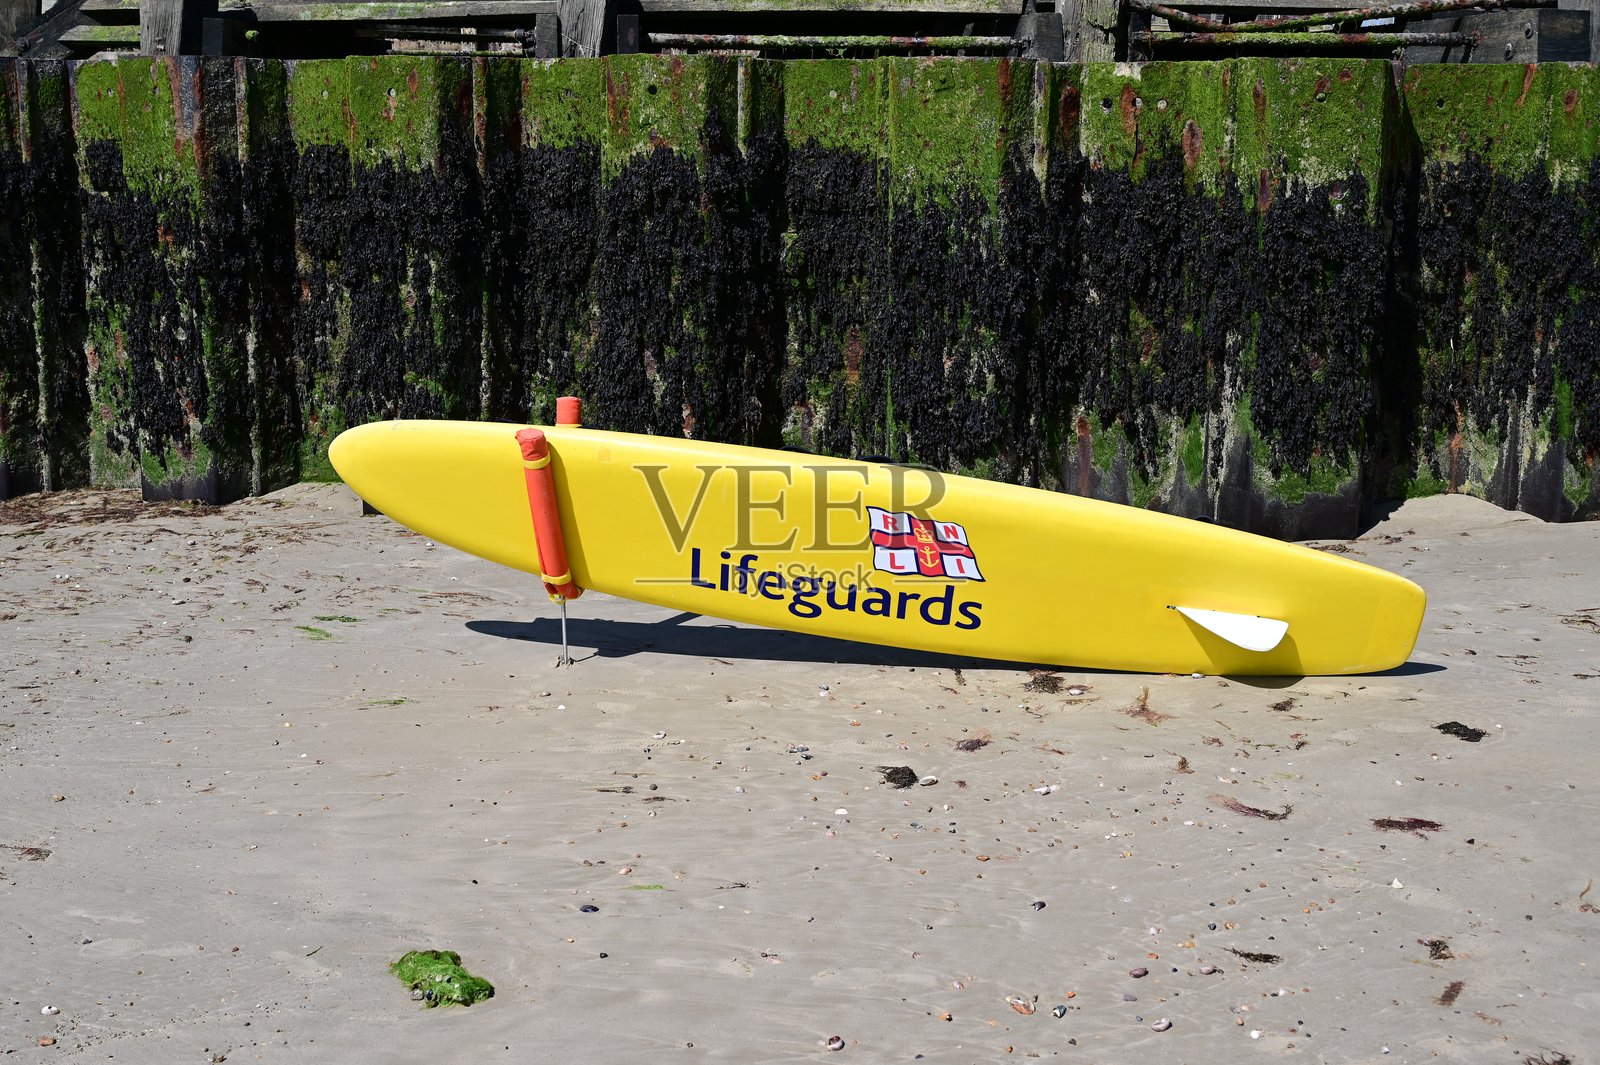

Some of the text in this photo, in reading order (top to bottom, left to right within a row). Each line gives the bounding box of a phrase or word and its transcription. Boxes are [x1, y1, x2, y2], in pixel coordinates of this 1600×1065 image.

[882, 513, 960, 540] R N
[889, 552, 965, 574] L I
[691, 547, 983, 630] Lifeguards
